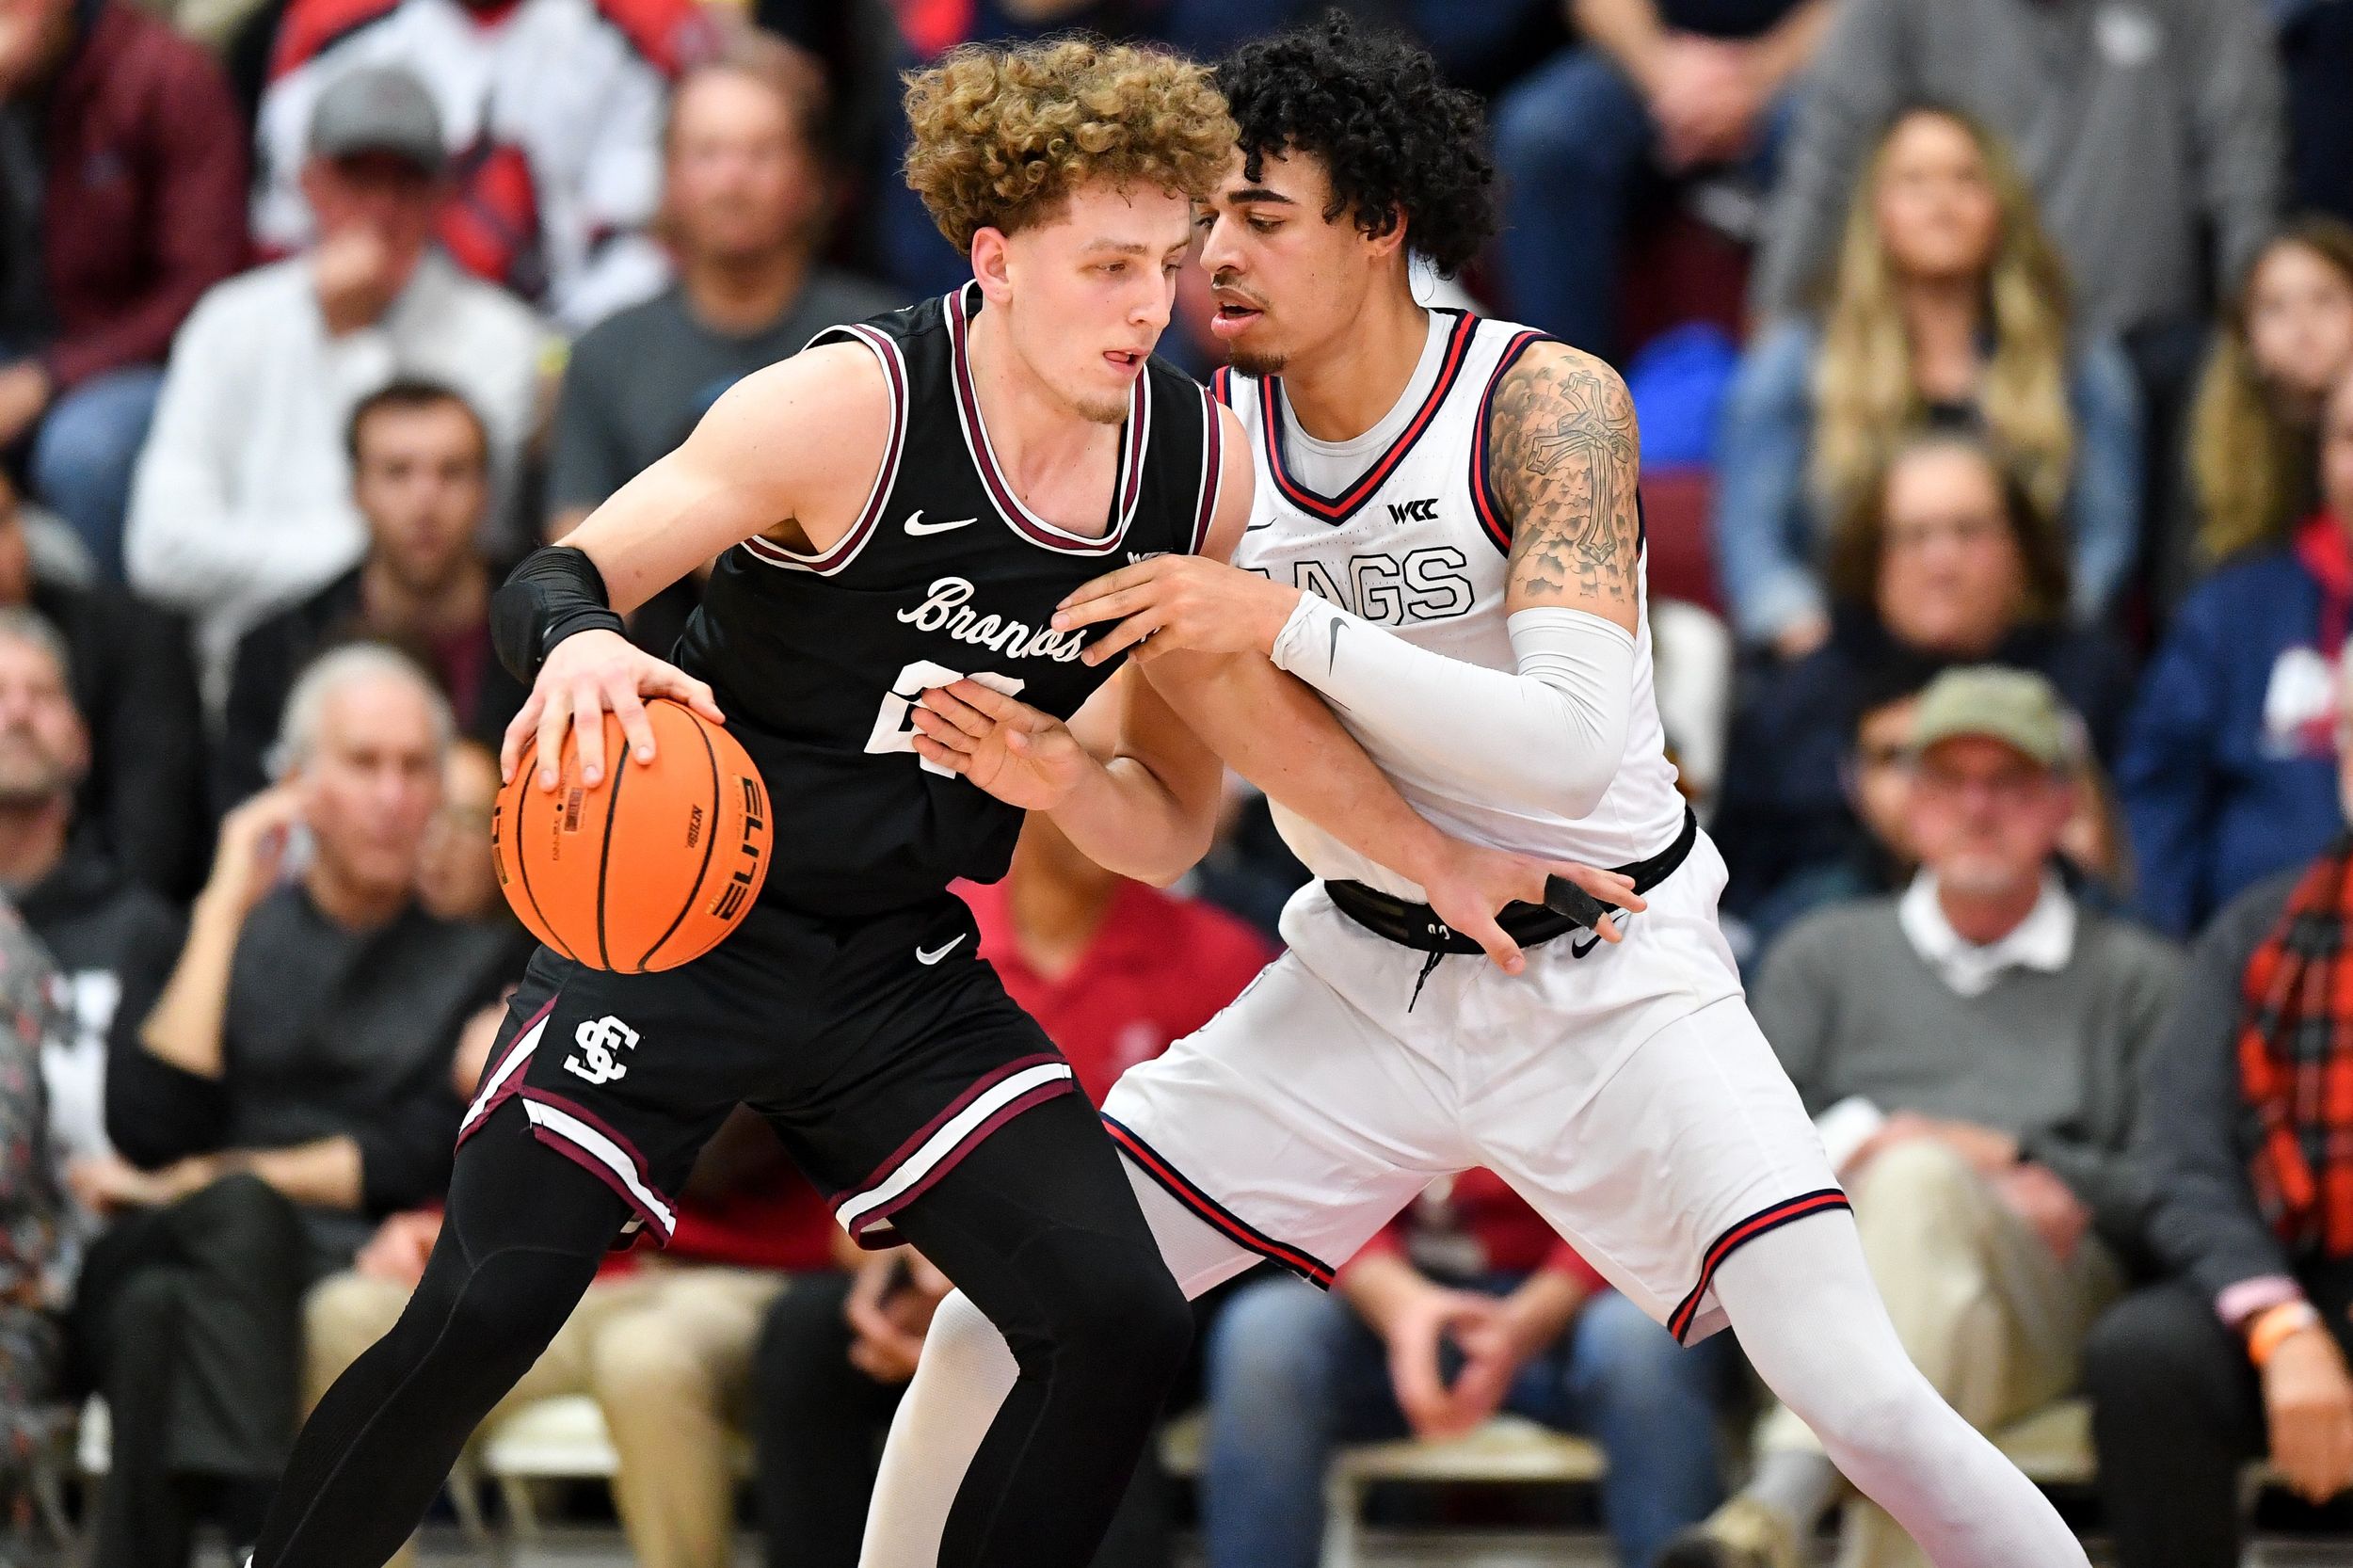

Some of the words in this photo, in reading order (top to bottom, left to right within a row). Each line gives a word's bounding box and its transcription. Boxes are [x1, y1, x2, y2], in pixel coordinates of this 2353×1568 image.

[1386, 498, 1439, 525] WCC
[896, 576, 1087, 663] Bronos
[1237, 545, 1476, 626] AGS
[712, 776, 764, 921] ELITE
